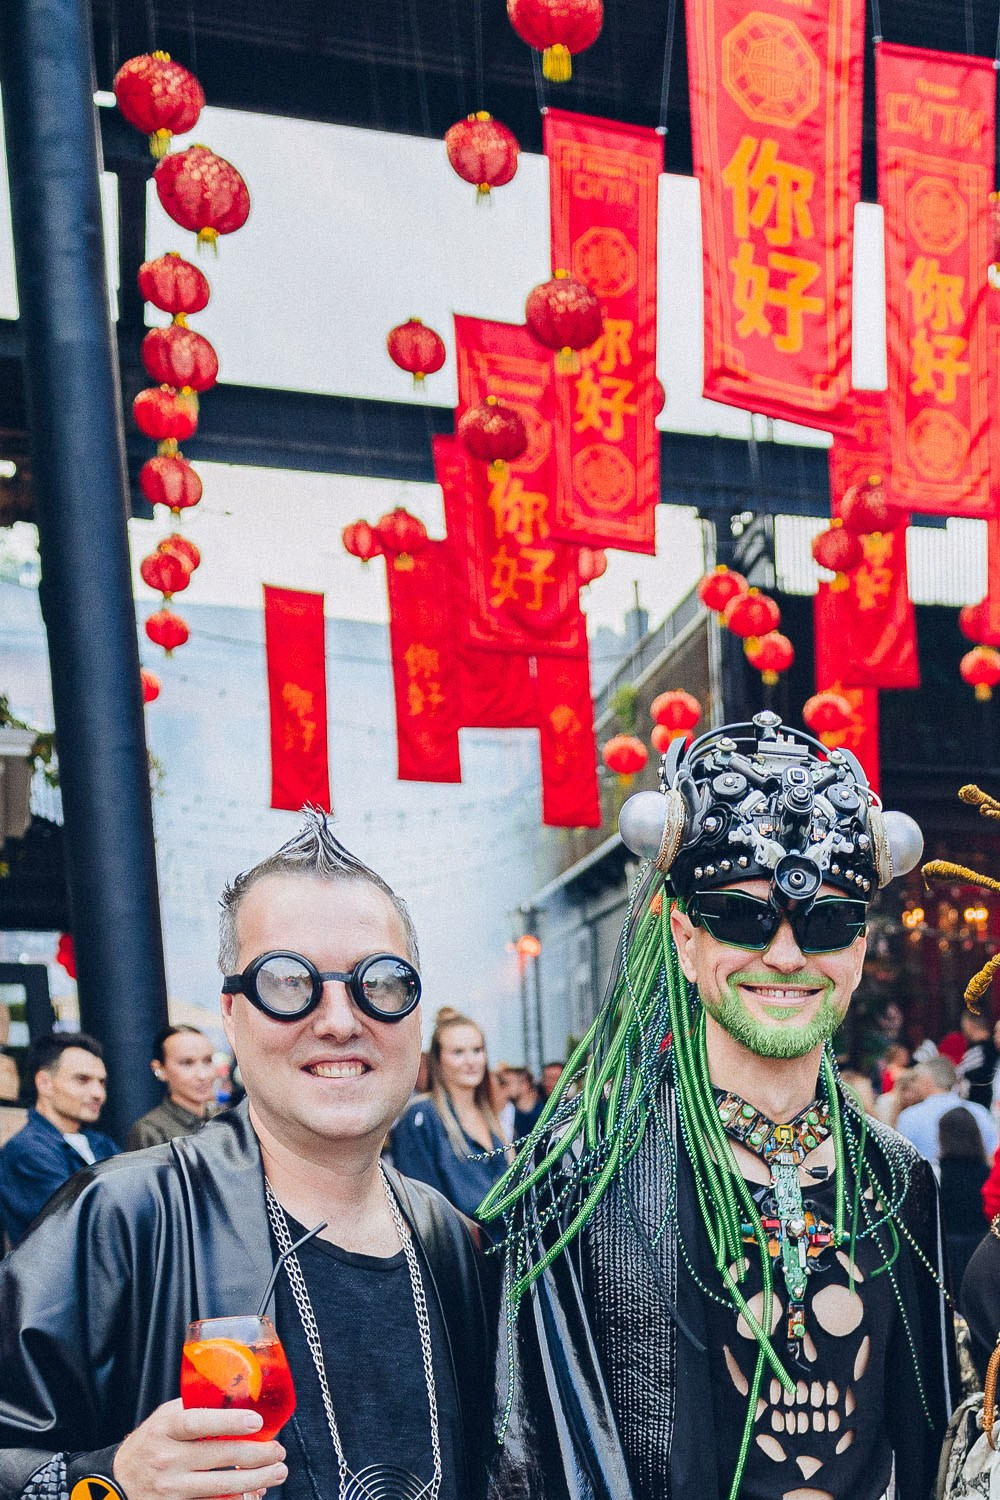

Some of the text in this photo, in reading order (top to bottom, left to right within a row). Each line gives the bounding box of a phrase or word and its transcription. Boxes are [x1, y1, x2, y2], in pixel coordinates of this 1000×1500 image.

[722, 136, 826, 354] 你好
[905, 256, 971, 404] 你好
[480, 467, 556, 612] 你好
